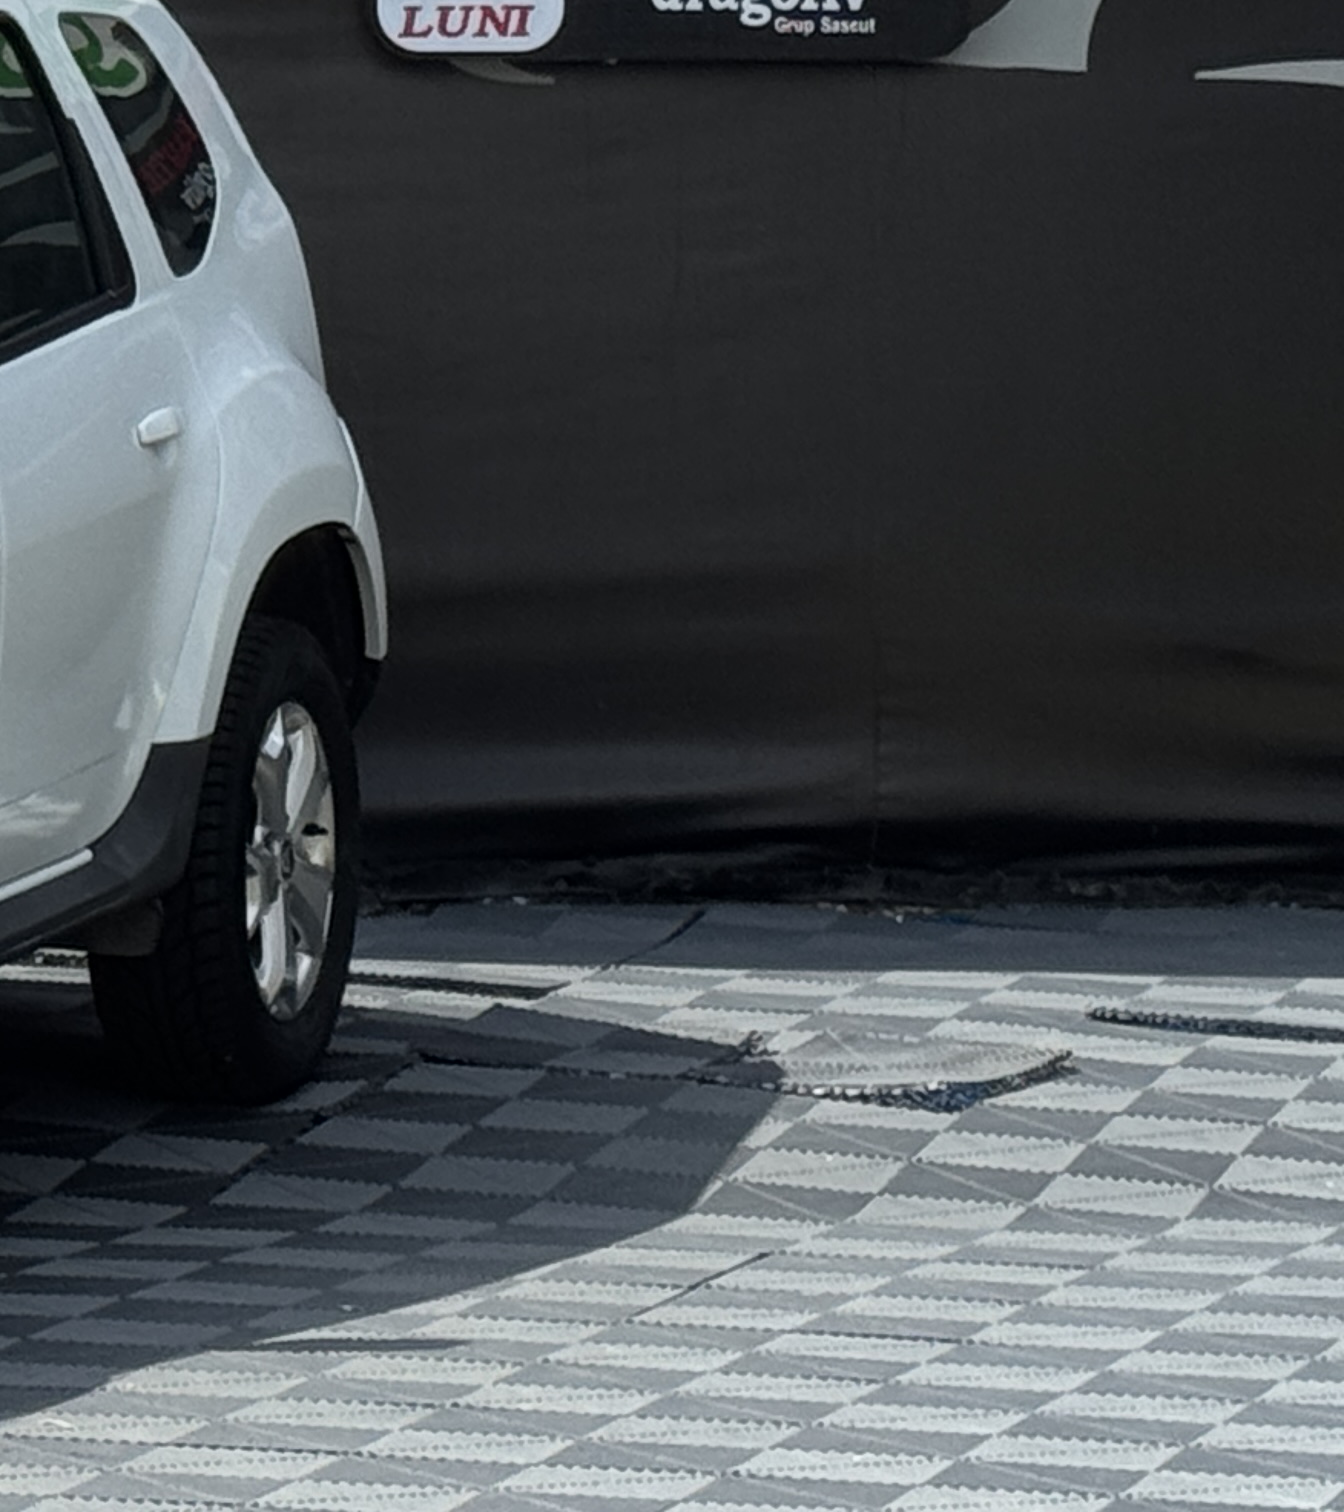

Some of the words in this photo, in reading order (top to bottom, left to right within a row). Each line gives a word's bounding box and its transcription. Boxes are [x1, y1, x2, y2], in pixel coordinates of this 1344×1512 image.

[398, 4, 536, 40] LUNI
[774, 16, 815, 37] Grup
[820, 15, 876, 35] Sascut
